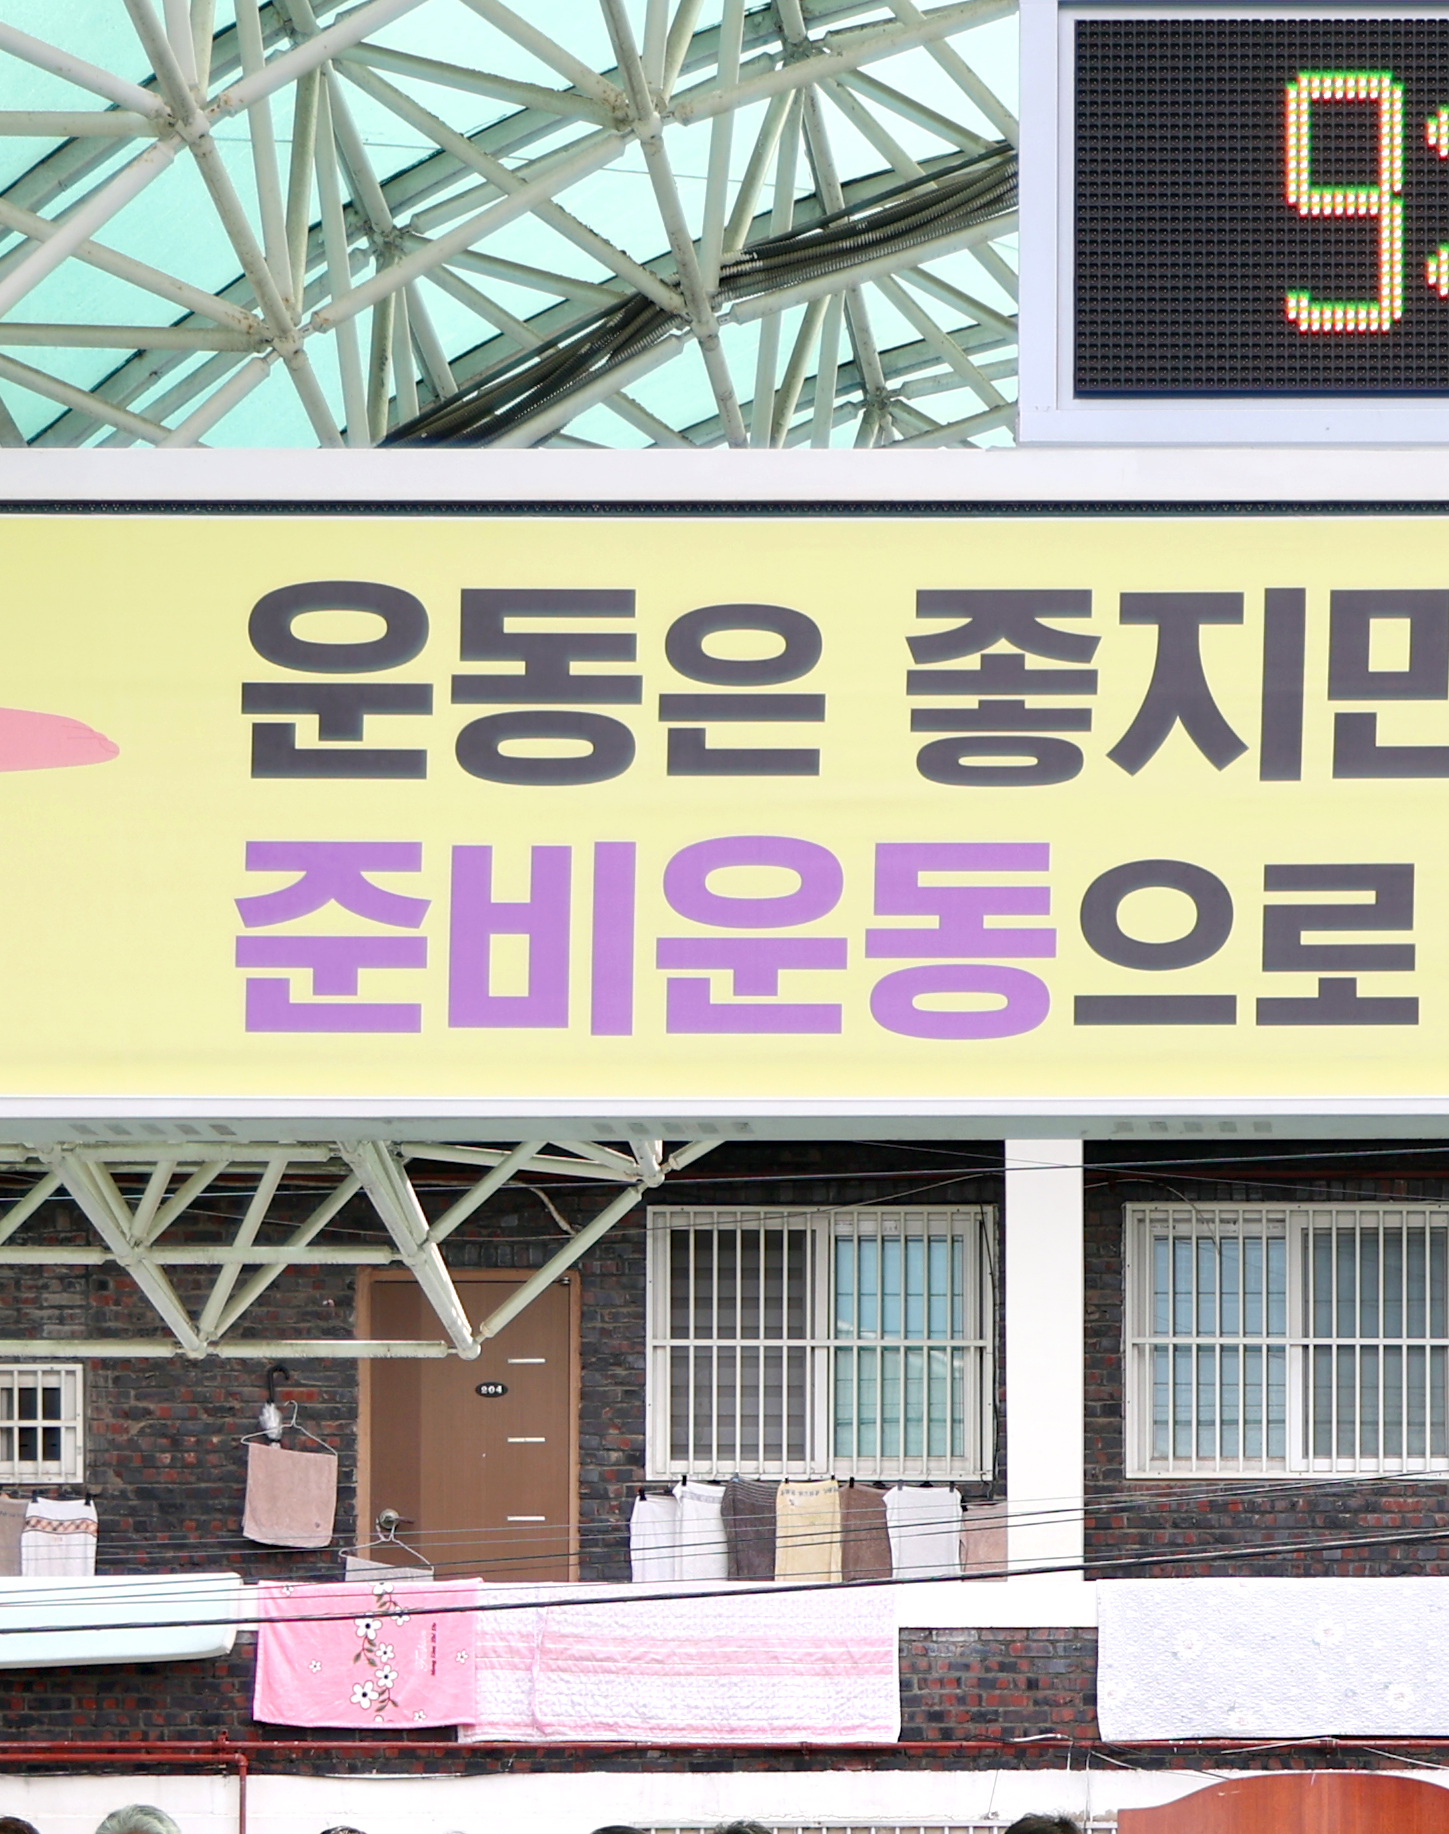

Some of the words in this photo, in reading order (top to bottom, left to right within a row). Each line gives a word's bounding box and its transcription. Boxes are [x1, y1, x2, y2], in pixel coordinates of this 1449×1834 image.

[241, 581, 825, 786] 운동은
[234, 836, 1419, 1039] 준비운동으로
[481, 1385, 503, 1394] 204
